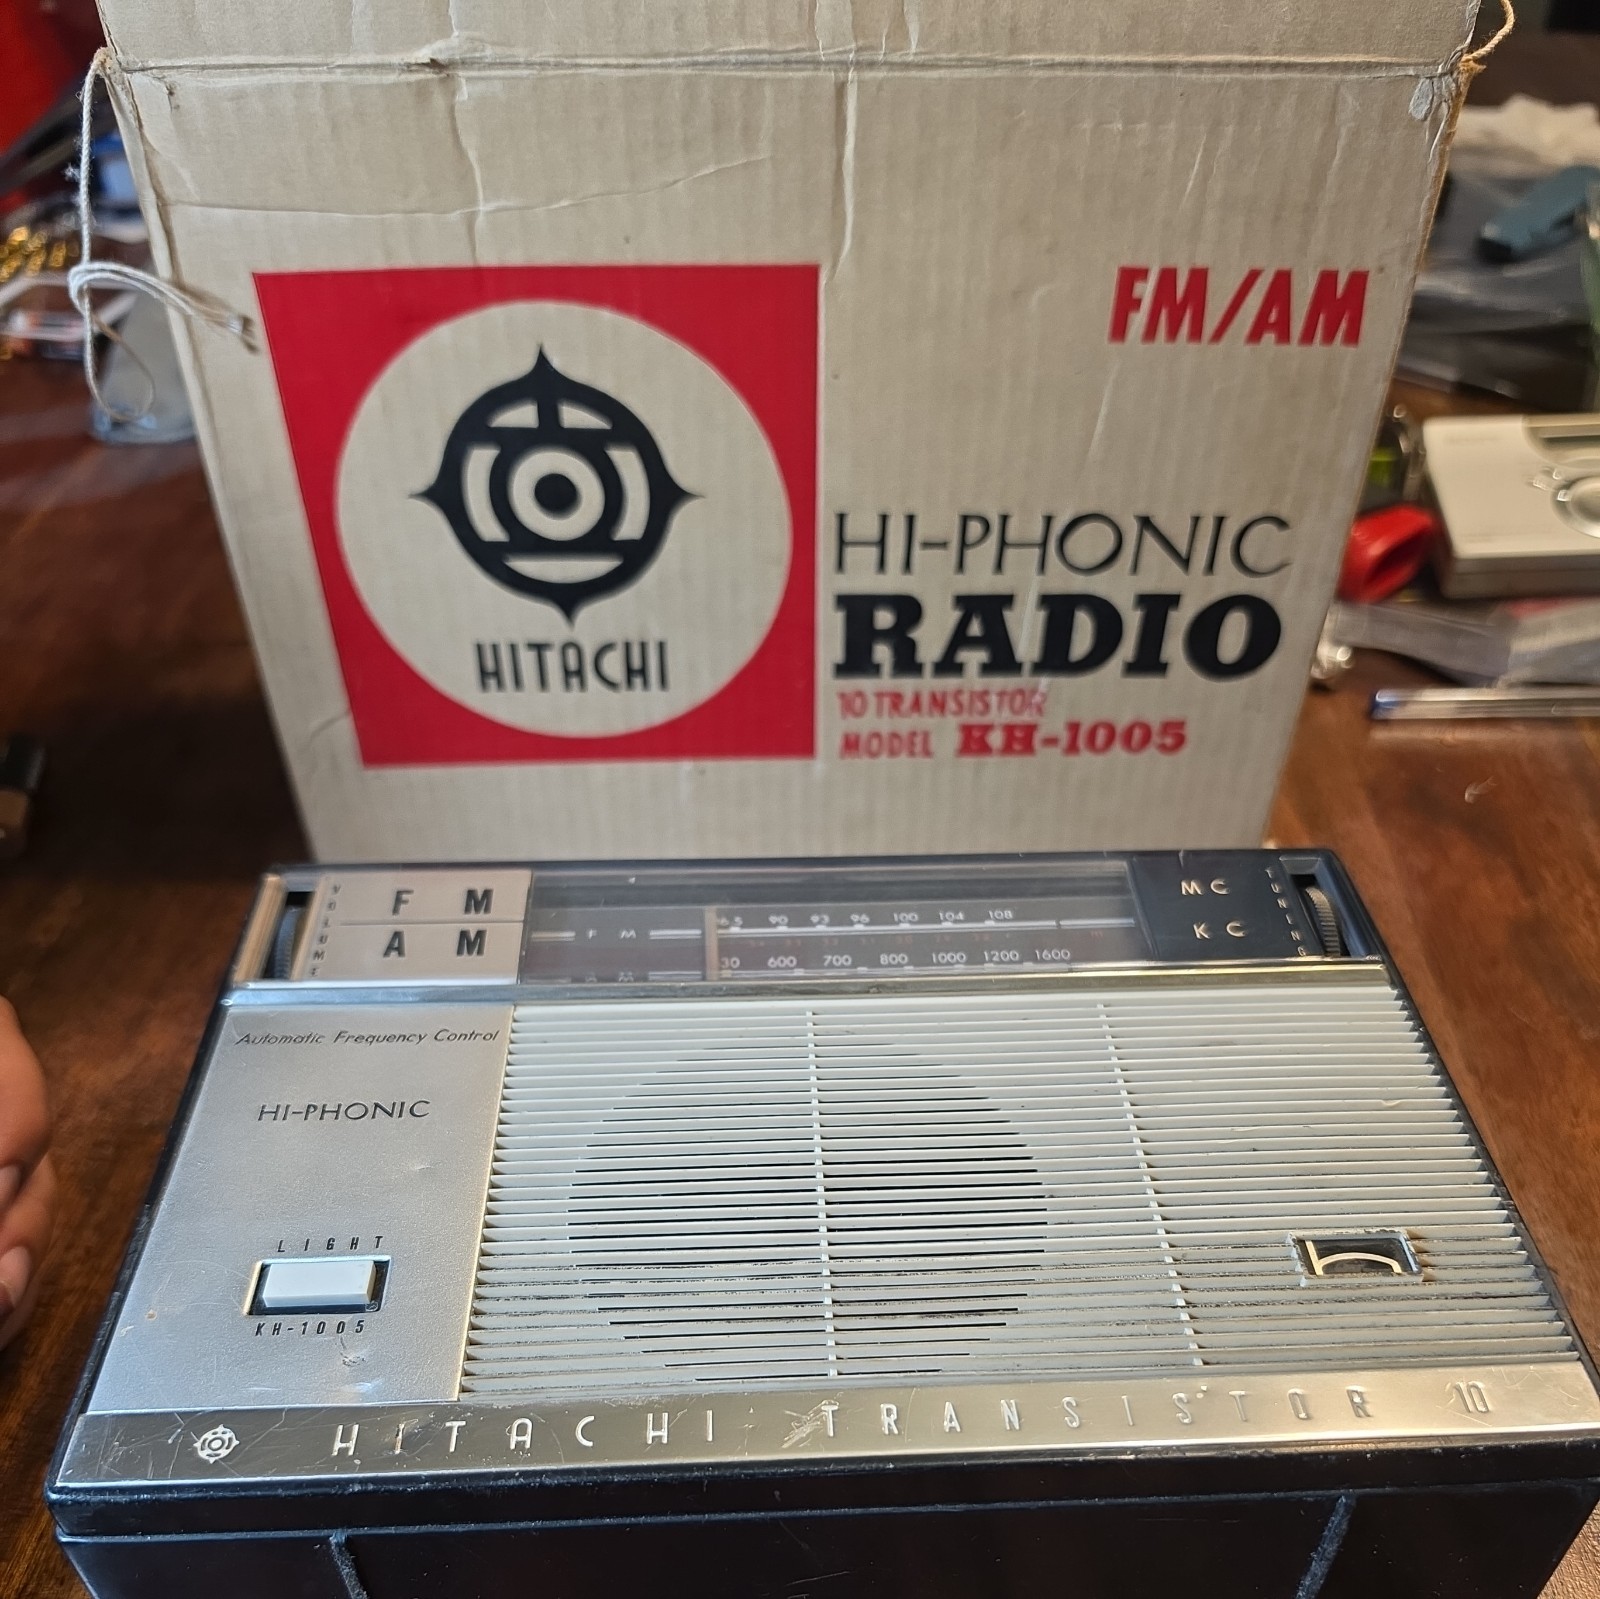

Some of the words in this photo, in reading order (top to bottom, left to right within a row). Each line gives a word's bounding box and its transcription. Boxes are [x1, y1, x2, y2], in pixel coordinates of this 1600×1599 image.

[1108, 266, 1371, 347] FM/AM
[833, 511, 1294, 577] HI-PHONIC
[833, 592, 1283, 681] RADIO
[474, 638, 671, 694] HITACHI
[837, 690, 869, 720] 10
[873, 688, 1047, 720] TRANSISTOR
[838, 730, 934, 760] MODEL
[956, 718, 1188, 758] KH-1005
[809, 914, 831, 924] 93
[893, 911, 919, 923] 100
[938, 910, 965, 922] 104
[988, 909, 1014, 921] 108
[720, 956, 741, 969] 30
[767, 955, 798, 968] 600
[823, 954, 853, 967] 700
[880, 953, 909, 966] 800
[931, 952, 967, 964] 1000
[983, 950, 1020, 963] 1200
[1034, 949, 1072, 961] 1600
[233, 1031, 325, 1046] Automatic
[333, 1030, 428, 1046] Frequency
[433, 1028, 501, 1043] Control
[257, 1100, 431, 1122] HI-PHONIC
[277, 1235, 384, 1253] LIGHT
[255, 1320, 366, 1337] KH-1005
[331, 1409, 715, 1457] HITACHI
[820, 1384, 1373, 1439] TRANSISTOR
[1453, 1380, 1493, 1414] 10
